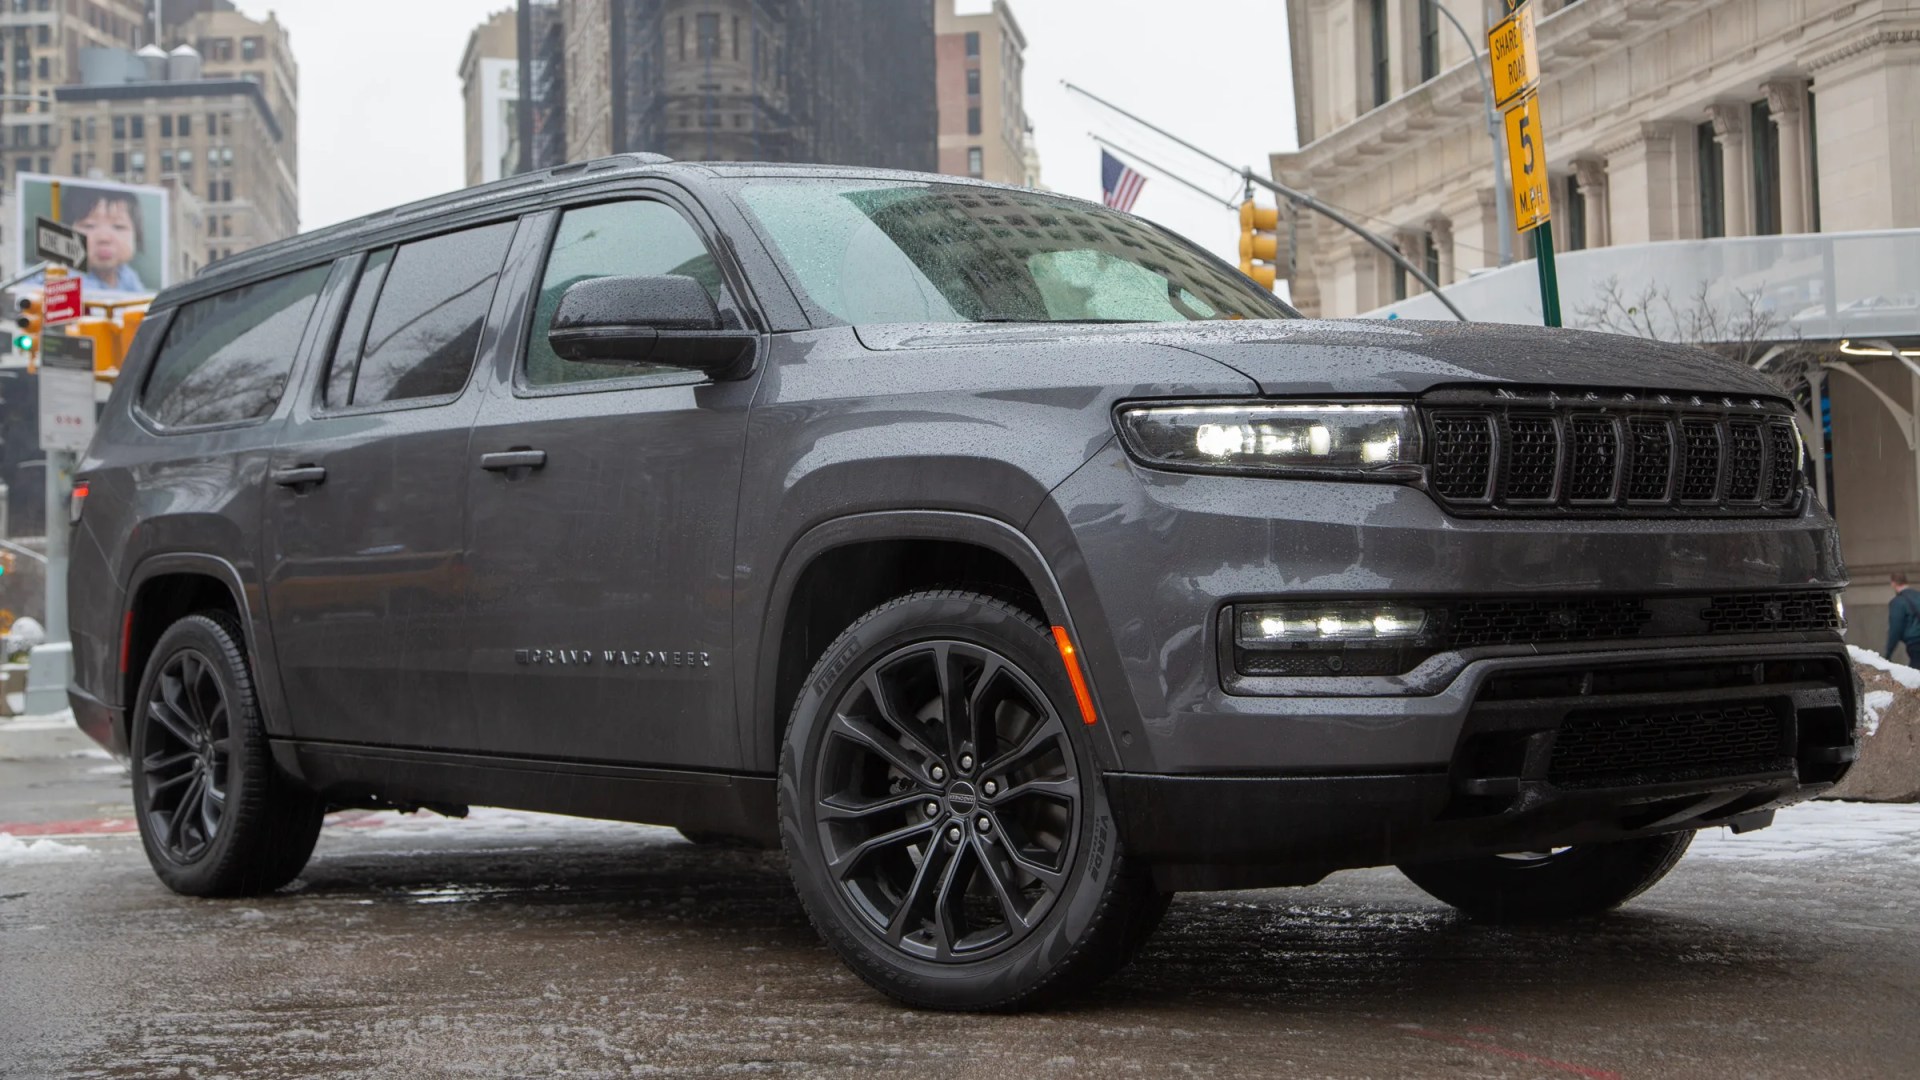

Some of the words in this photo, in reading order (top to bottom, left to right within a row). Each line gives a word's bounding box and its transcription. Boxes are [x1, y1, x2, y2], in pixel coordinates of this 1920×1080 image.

[1494, 26, 1519, 61] SHARE
[1508, 54, 1527, 85] ROAD
[1519, 115, 1535, 175] 5
[42, 231, 58, 251] ONE
[65, 241, 81, 260] WAY
[532, 649, 592, 664] GRAND
[604, 650, 711, 667] WAGONEER
[812, 635, 862, 697] PIRELLI
[1091, 815, 1109, 882] VERDE
